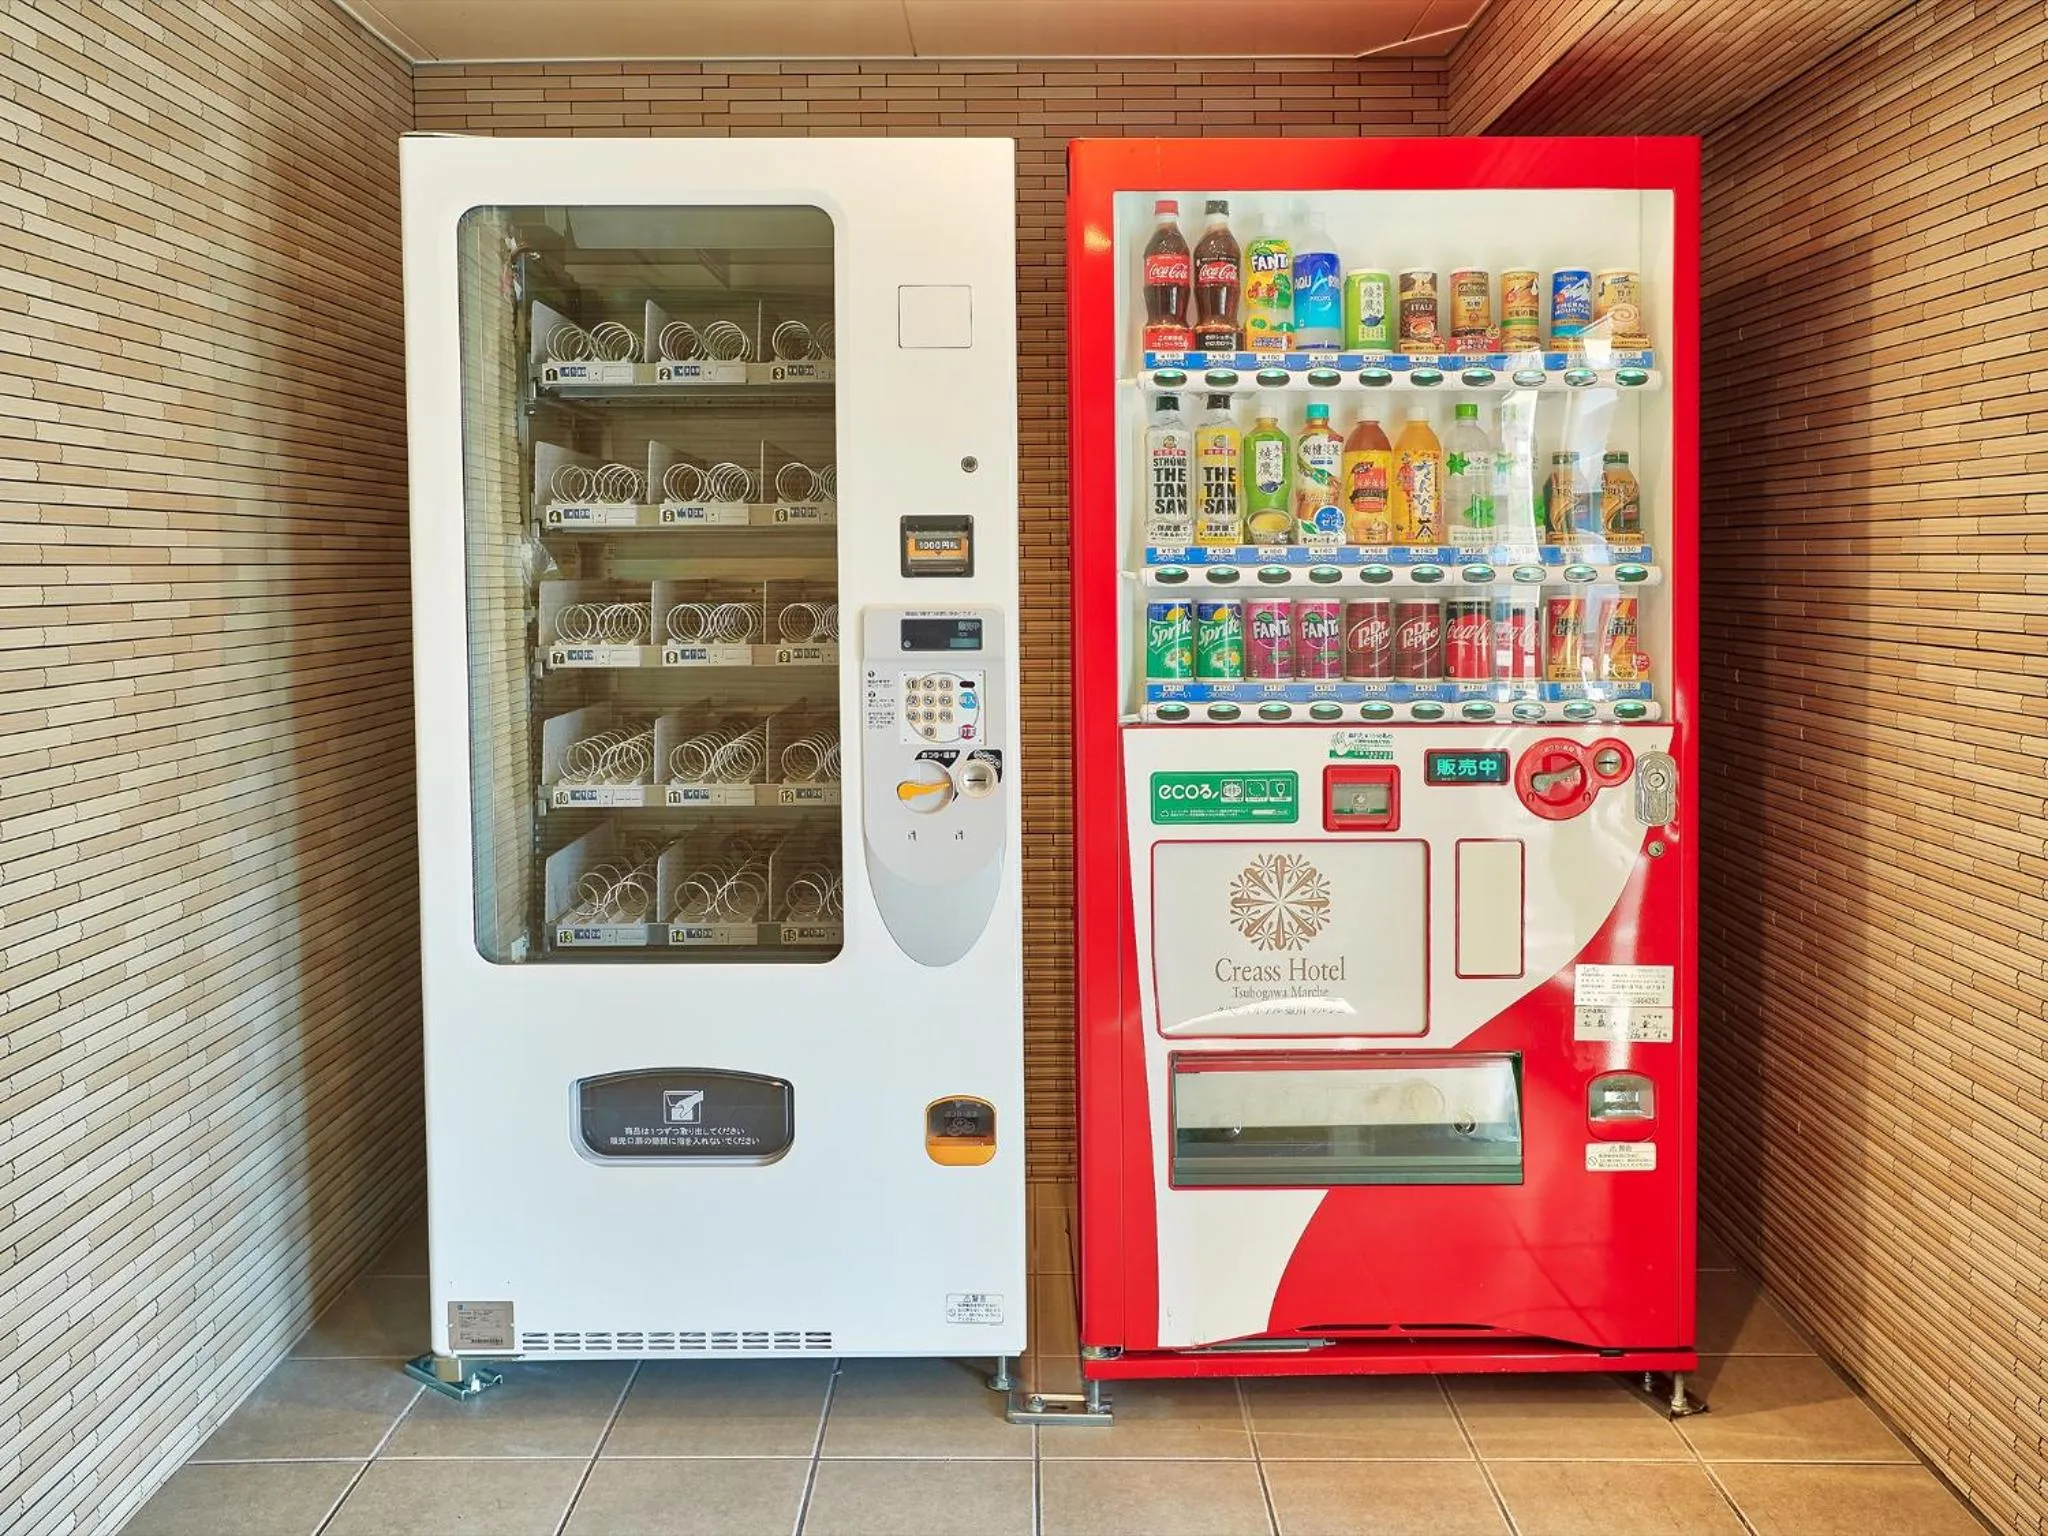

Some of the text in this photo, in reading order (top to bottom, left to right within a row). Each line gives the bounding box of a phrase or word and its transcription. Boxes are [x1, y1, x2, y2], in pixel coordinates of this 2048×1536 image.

[1153, 458, 1187, 467] STRONG
[1153, 468, 1187, 482] THE
[1203, 467, 1236, 482] THE
[1154, 483, 1187, 498] TAN
[1204, 483, 1236, 498] TAN
[1154, 500, 1188, 515] SAN
[1204, 500, 1236, 514] SAN
[920, 541, 958, 550] 1000円札
[1150, 617, 1192, 646] Sprite
[1198, 616, 1240, 646] Sprite
[1371, 620, 1386, 634] Dr
[1414, 621, 1431, 634] Dr
[1436, 758, 1498, 776] 販売中
[1215, 955, 1347, 982] Creass Hotel
[1233, 986, 1288, 1001] Tsubogawa
